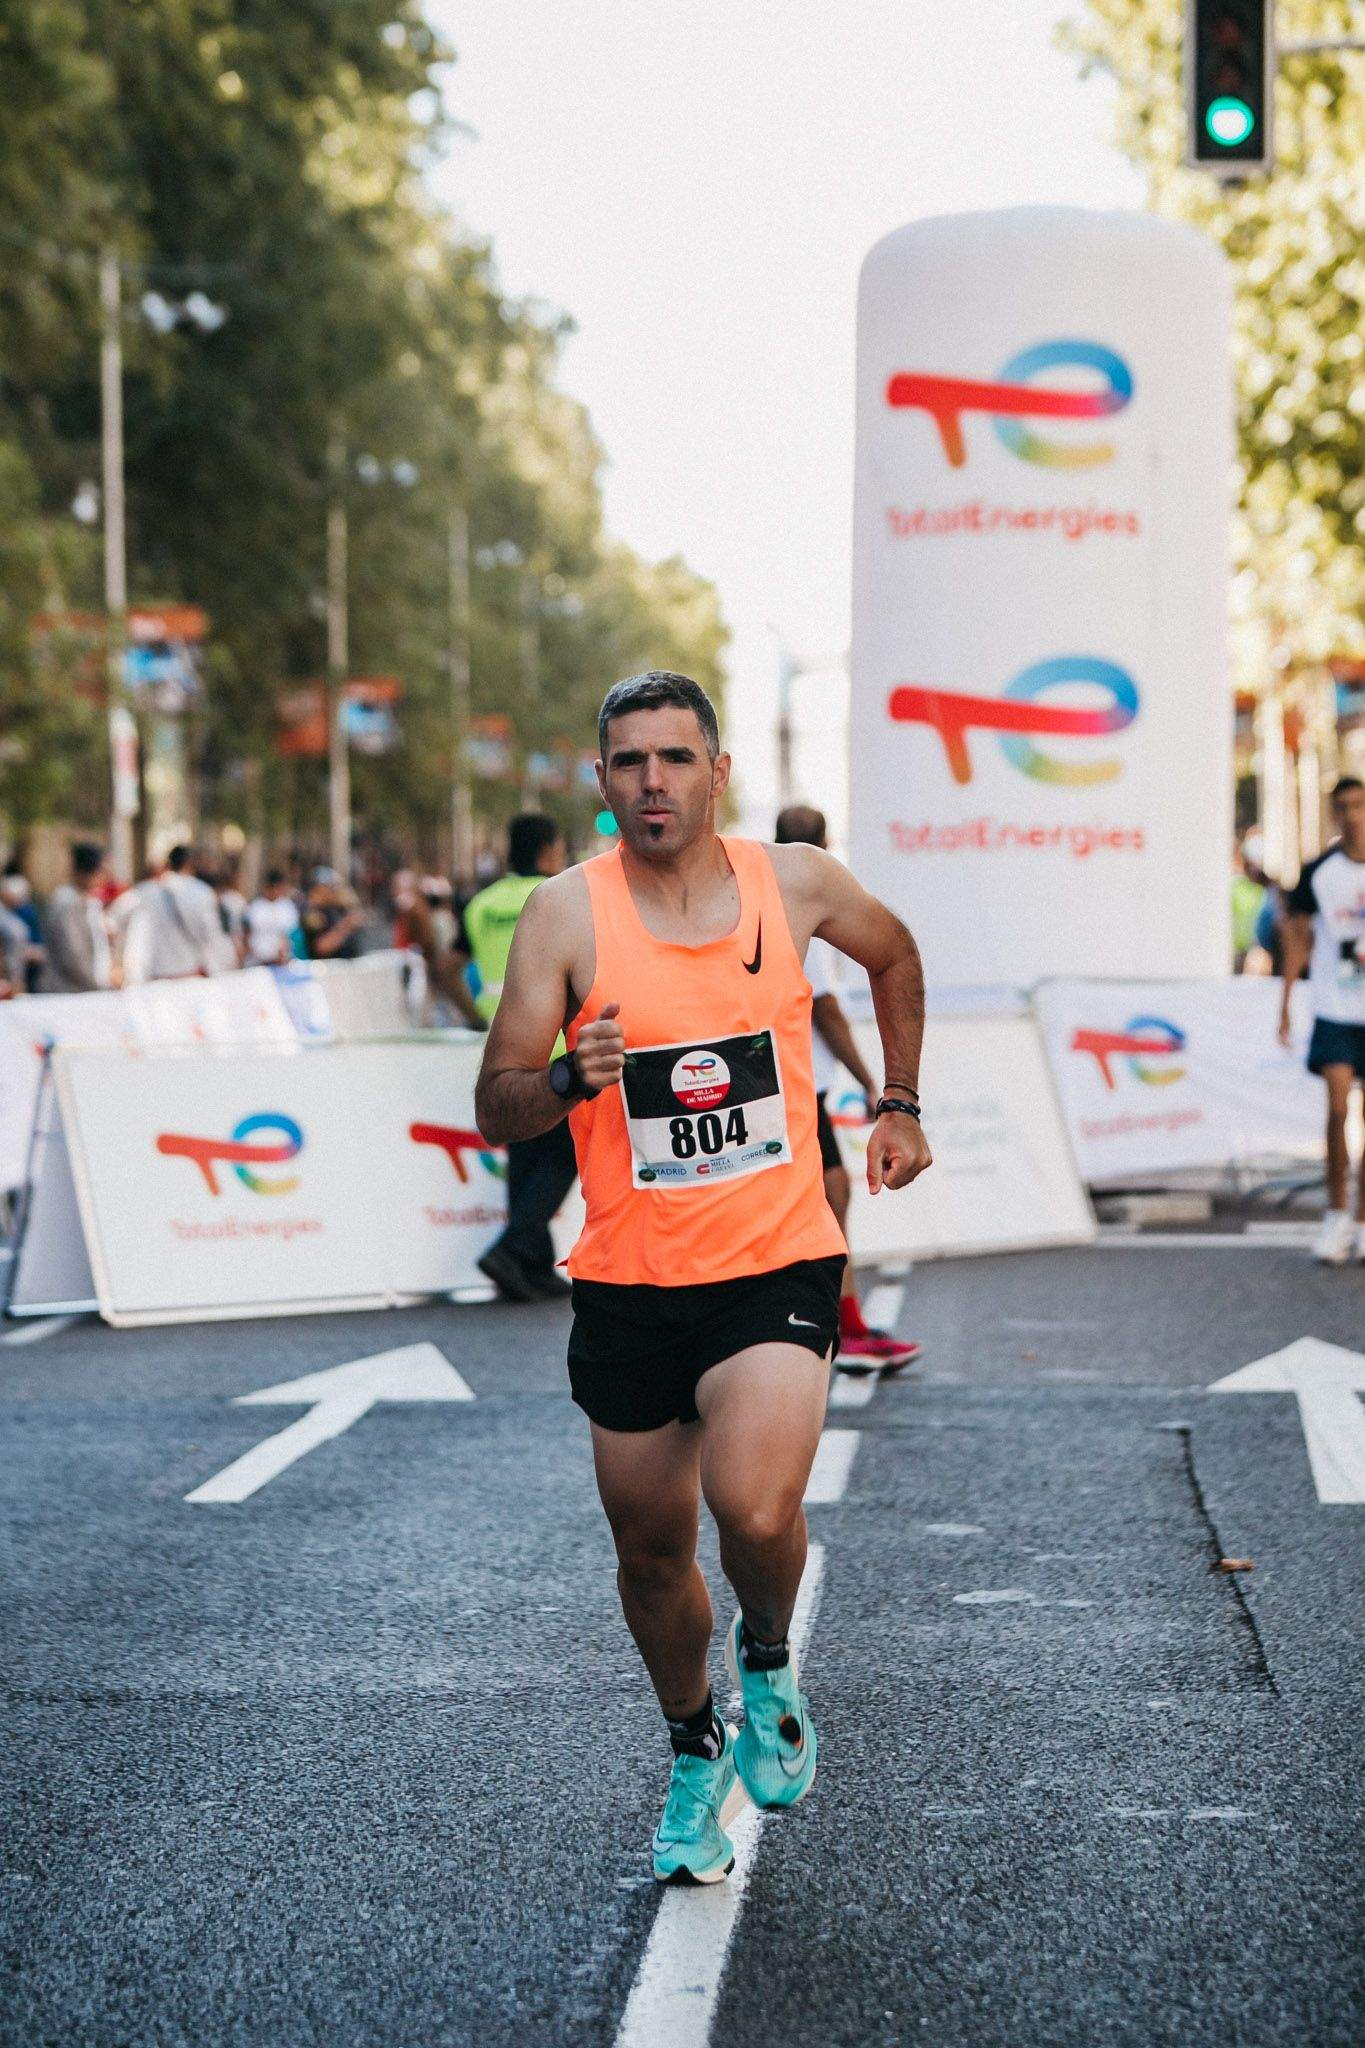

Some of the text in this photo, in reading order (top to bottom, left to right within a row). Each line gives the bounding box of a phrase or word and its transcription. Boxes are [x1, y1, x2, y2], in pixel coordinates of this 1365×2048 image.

[693, 1088, 715, 1096] MILLA
[686, 1093, 723, 1104] DE MADRID
[669, 1107, 749, 1159] 804
